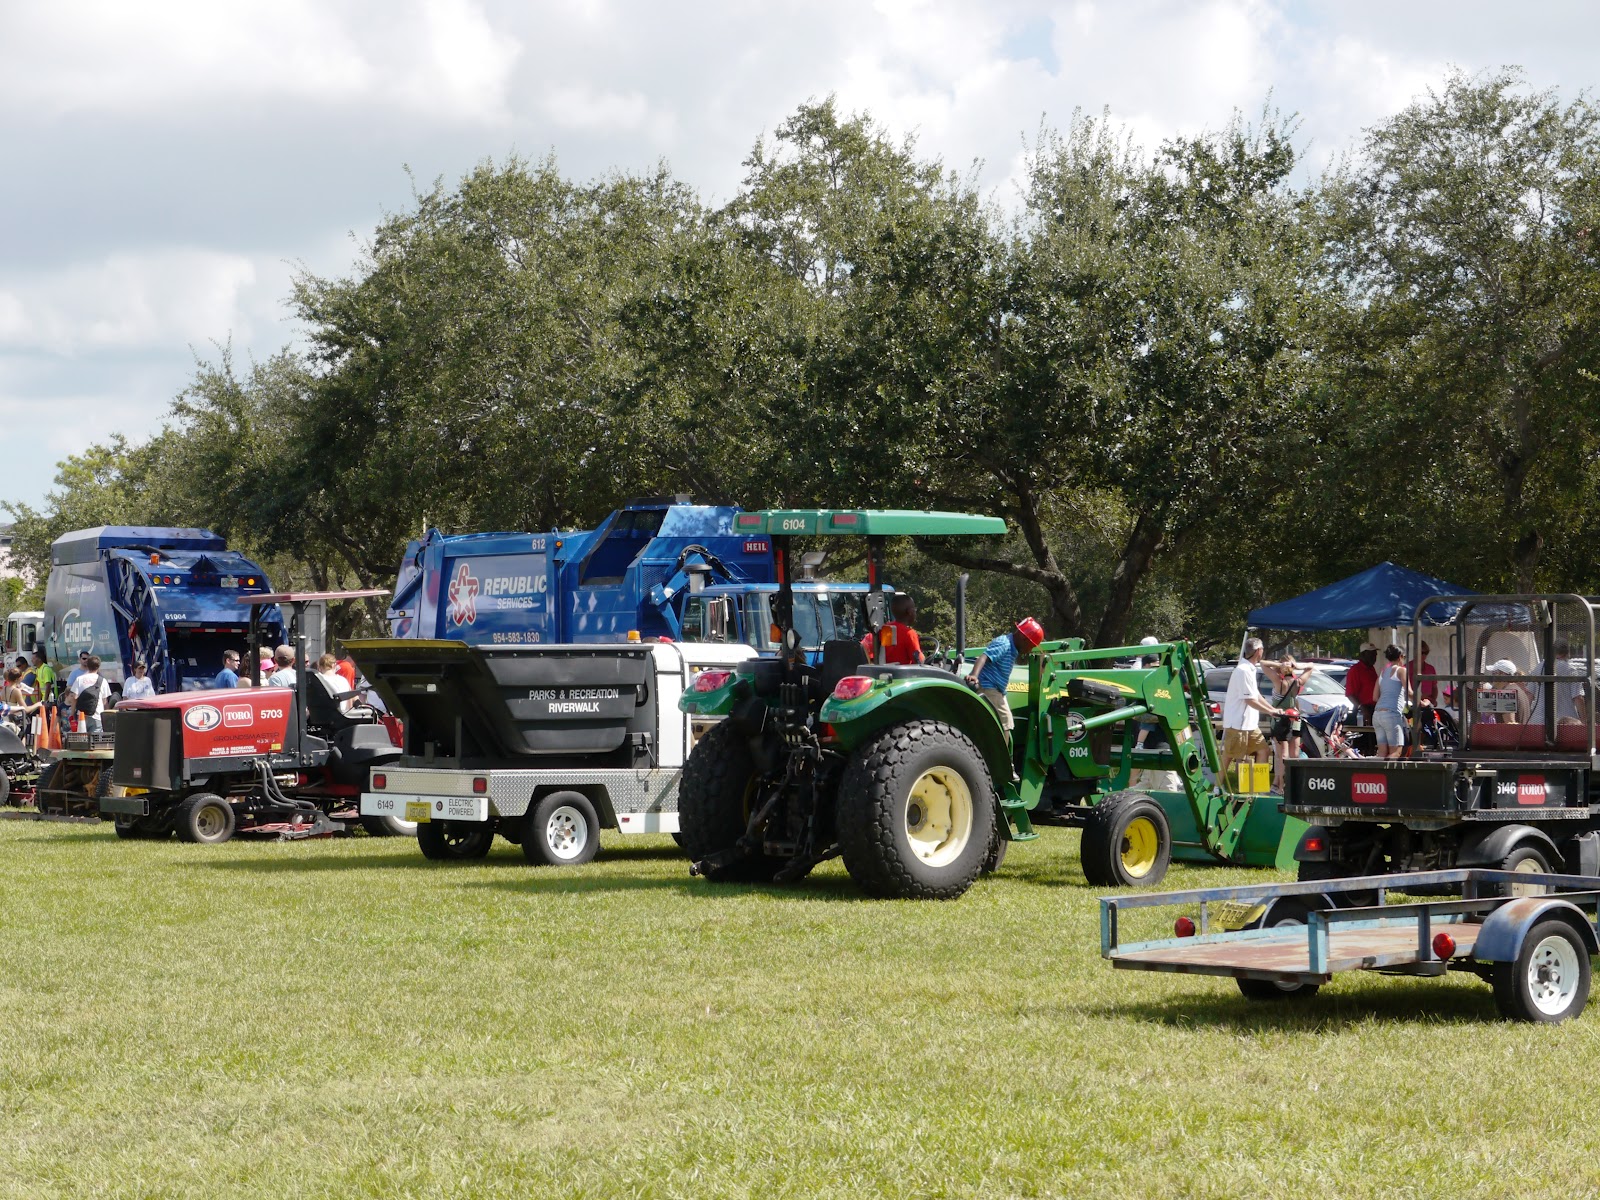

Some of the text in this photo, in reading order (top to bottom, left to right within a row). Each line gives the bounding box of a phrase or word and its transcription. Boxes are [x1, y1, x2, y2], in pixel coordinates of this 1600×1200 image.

[783, 519, 805, 530] 6104
[746, 543, 767, 551] HEIL
[484, 575, 547, 596] REPUBLIC
[497, 597, 533, 609] SERVICES
[65, 622, 91, 642] CHOICE
[493, 632, 540, 643] 954-583-1830
[529, 689, 619, 700] PARKS & RECREATION
[549, 702, 600, 713] RIVERWALK
[226, 711, 251, 720] TORO
[261, 709, 283, 719] 5703
[214, 732, 280, 742] GROUNDSMASTER
[1069, 748, 1088, 757] 6104
[1308, 778, 1336, 790] 6146
[1354, 783, 1385, 794] TORO
[1520, 784, 1543, 795] TORO
[377, 800, 394, 810] 6149
[449, 799, 473, 808] ELECTRIC
[449, 808, 474, 816] POWERED
